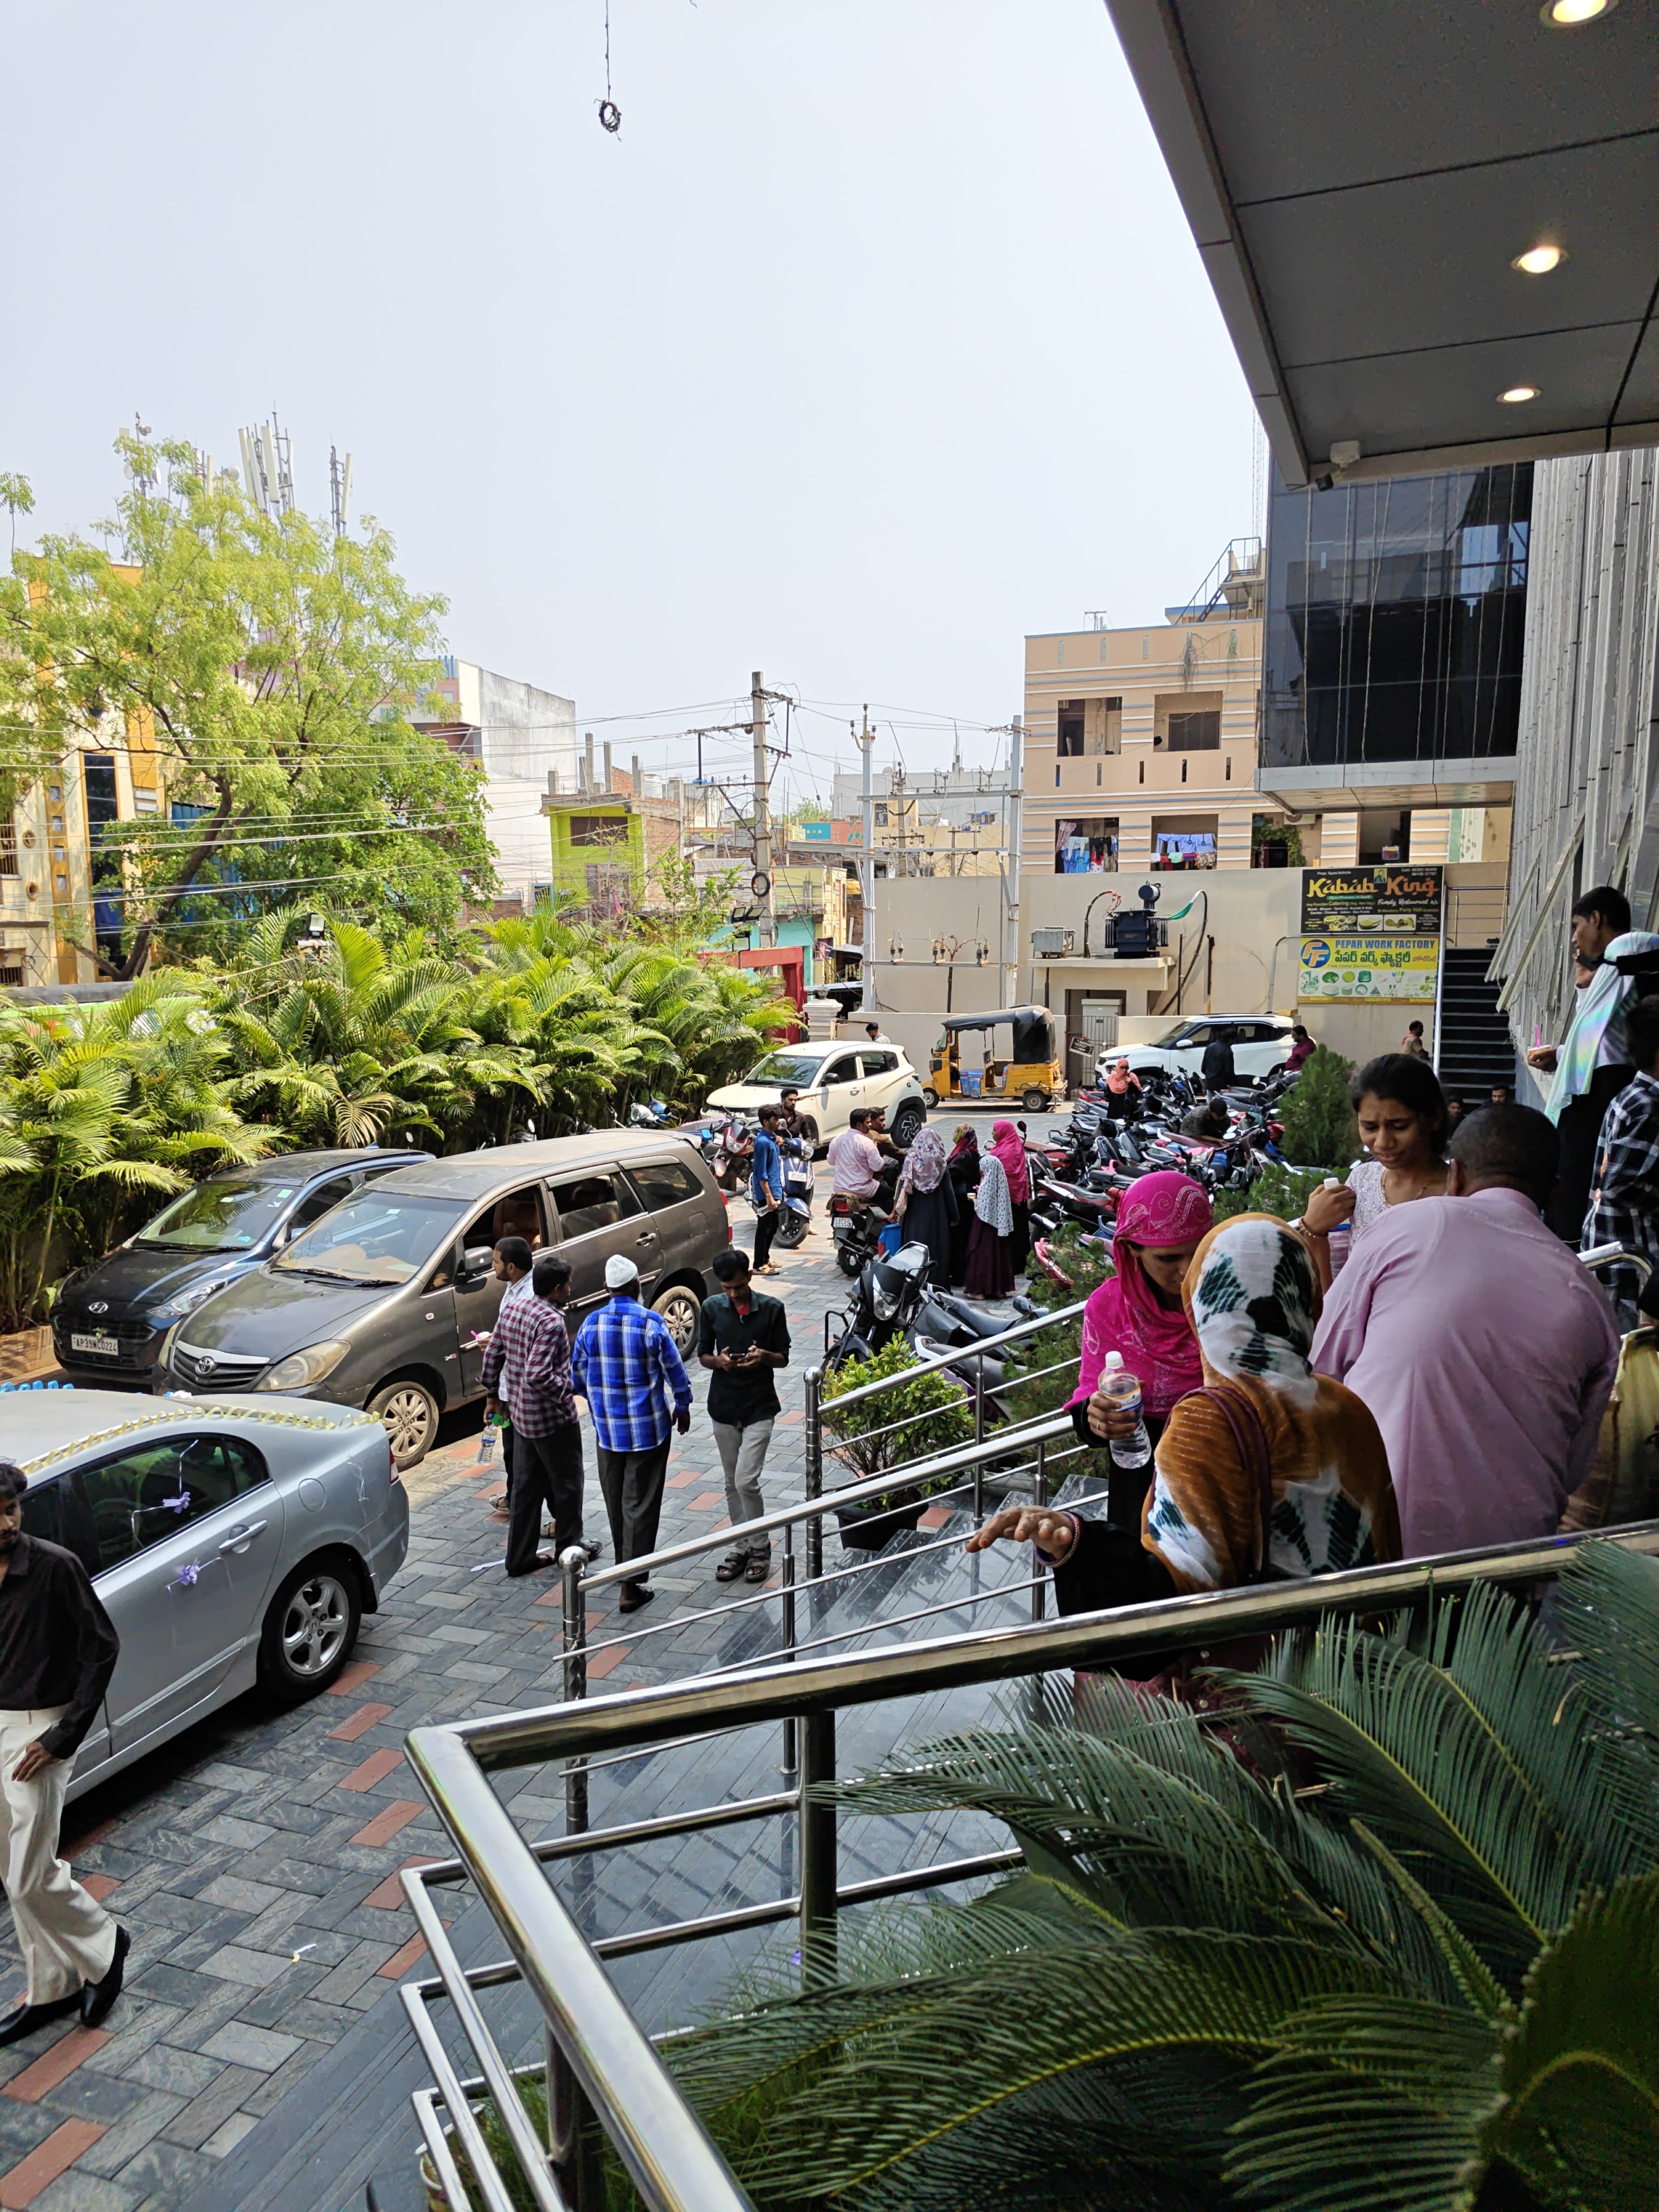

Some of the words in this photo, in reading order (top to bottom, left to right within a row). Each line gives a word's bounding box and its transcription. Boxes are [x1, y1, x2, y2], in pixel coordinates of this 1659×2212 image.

[1306, 877, 1379, 898] Kabab
[1384, 876, 1440, 897] King
[1378, 899, 1396, 907] Family
[1336, 940, 1362, 949] PEPAR
[1365, 940, 1392, 949] WORK
[1395, 940, 1435, 949] FACTORY
[1335, 950, 1357, 962] పేపర్
[1360, 951, 1378, 966] వర్క్
[1380, 951, 1410, 968] ఫ్యాక్టరీ
